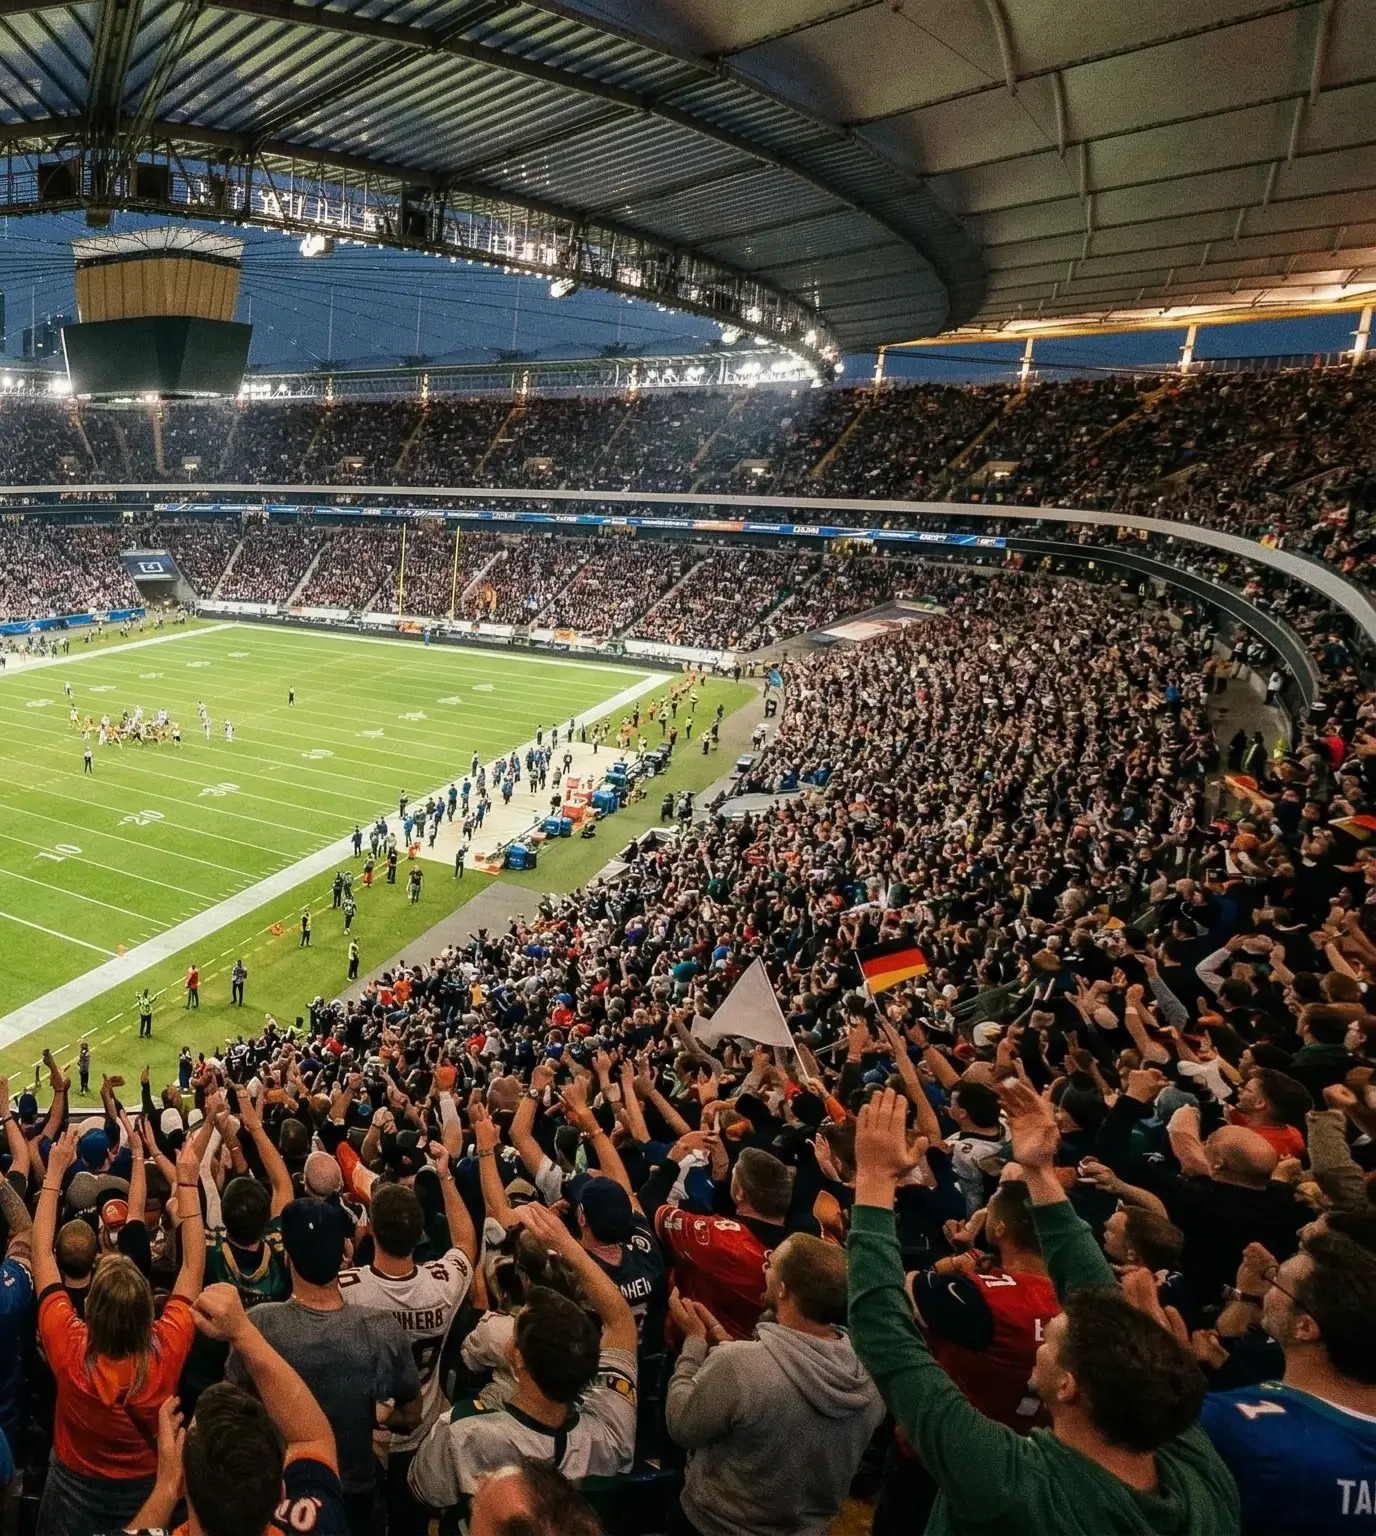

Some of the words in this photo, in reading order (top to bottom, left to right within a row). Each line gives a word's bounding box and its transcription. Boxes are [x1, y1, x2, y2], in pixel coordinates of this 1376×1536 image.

[121, 809, 165, 826] 20
[33, 843, 83, 864] 10
[1337, 1478, 1376, 1515] TA
